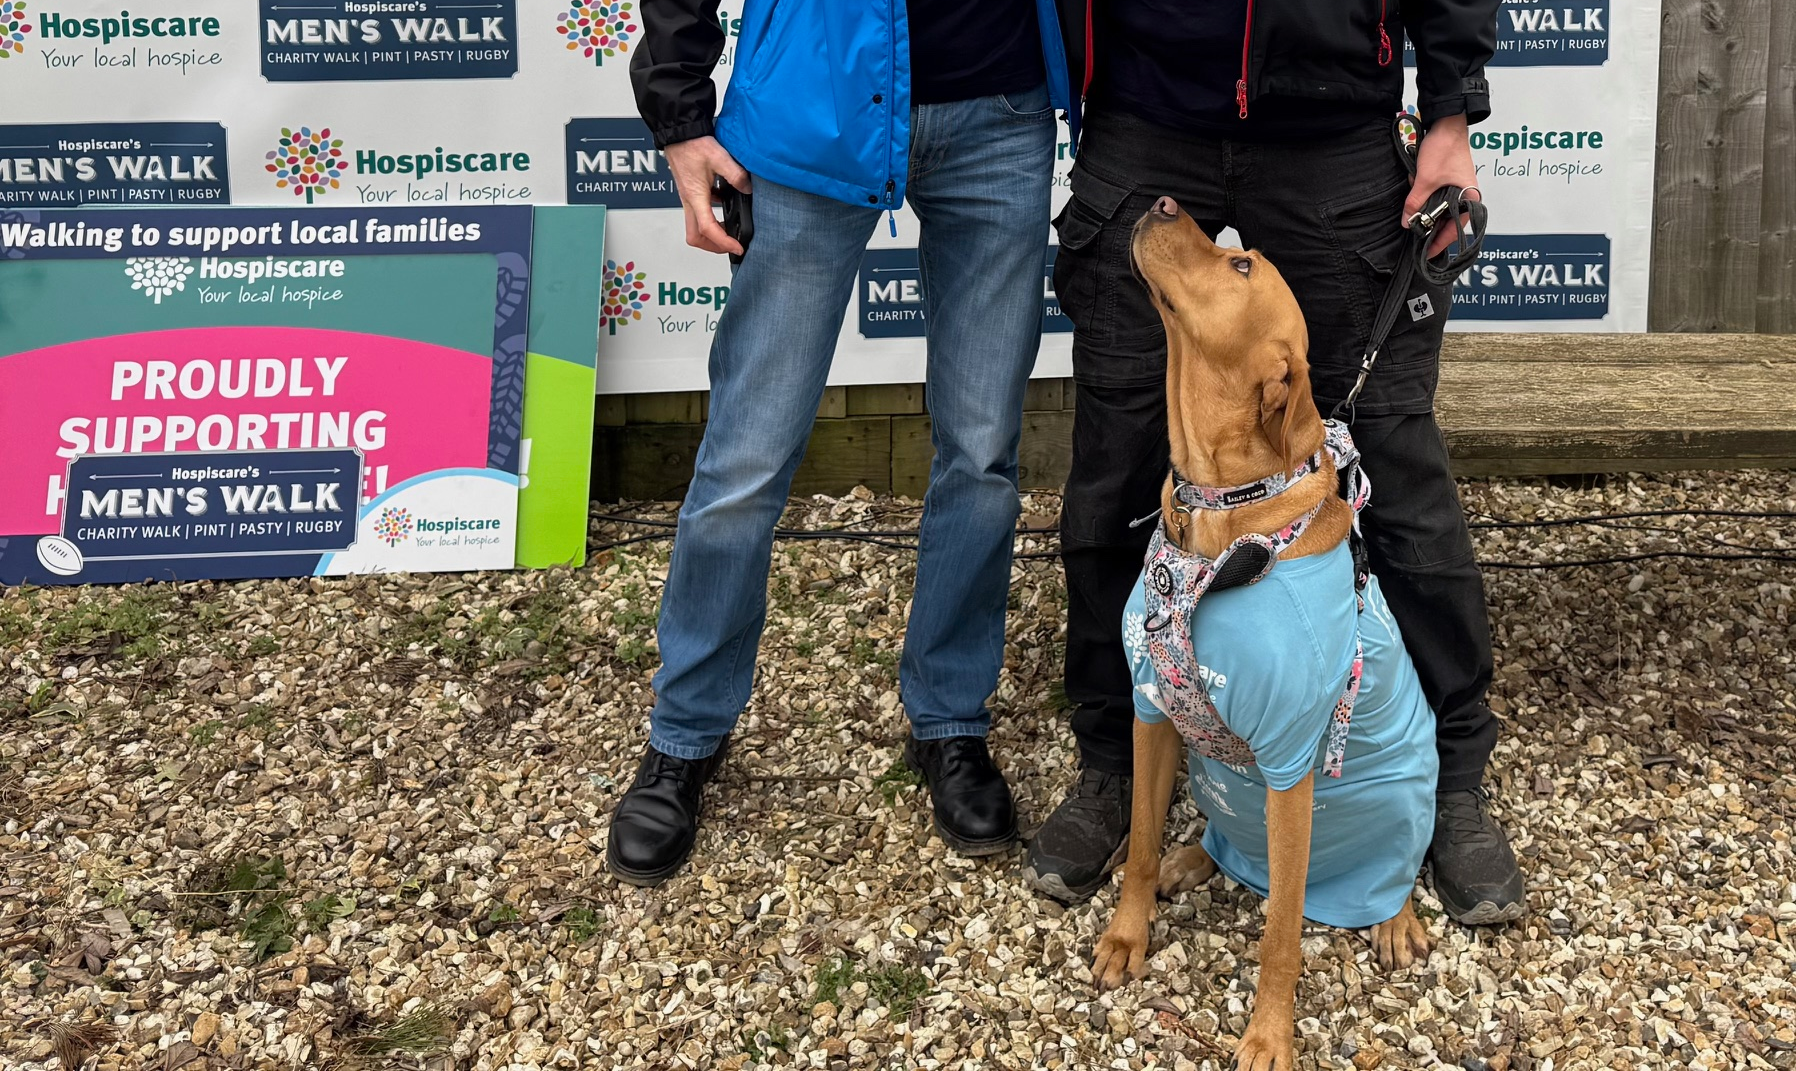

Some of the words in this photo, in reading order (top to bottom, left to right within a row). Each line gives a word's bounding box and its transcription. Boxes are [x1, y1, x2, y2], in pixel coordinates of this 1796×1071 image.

[344, 0, 427, 16] Hospiscare's
[40, 10, 220, 45] Hospiscare
[266, 18, 382, 45] MEN'S
[396, 17, 509, 44] WALK
[1507, 8, 1605, 33] WALK
[267, 51, 320, 64] CHARITY
[323, 51, 361, 64] WALK
[372, 50, 402, 63] PINT
[414, 50, 455, 62] PASTY
[466, 49, 510, 62] RUGBY
[1496, 40, 1515, 50] INT
[1525, 40, 1558, 50] PASTY
[1569, 39, 1607, 50] RUGBY
[41, 49, 84, 69] Your
[94, 48, 136, 69] local
[148, 49, 222, 75] hospice
[58, 138, 141, 153] Hospiscare's
[1470, 125, 1604, 156] ospiscare
[106, 155, 219, 183] WALK
[356, 147, 531, 179] Hospiscare
[575, 149, 671, 175] MEN'
[1494, 158, 1531, 177] local
[1539, 159, 1603, 184] hospice
[0, 190, 34, 202] ARITY
[38, 190, 75, 201] WALK
[88, 189, 118, 200] PINT
[129, 188, 169, 200] PASTY
[177, 187, 221, 200] RUGBY
[356, 184, 398, 204] Your
[408, 183, 448, 203] local
[459, 184, 532, 205] hospice
[576, 181, 628, 193] CHARITY
[631, 180, 666, 192] WALK
[1, 222, 124, 253] Walking
[131, 225, 160, 247] to
[168, 220, 284, 252] support
[290, 218, 359, 245] local
[366, 217, 481, 244] families
[1477, 249, 1539, 261] ospiscare's
[199, 256, 345, 283] Hospiscare
[1508, 263, 1606, 288] WALK
[198, 286, 231, 304] Your
[238, 285, 274, 304] local
[282, 286, 344, 309] hospice
[1489, 294, 1515, 305] PINT
[1525, 293, 1559, 304] PASTY
[1569, 292, 1607, 304] RUGBY
[658, 315, 696, 334] Your
[867, 310, 917, 322] CHARITY
[111, 356, 348, 401] PROUDLY
[56, 410, 387, 459] SUPPORTING
[172, 466, 260, 481] Hospiscare's
[80, 486, 208, 519] MEN'S
[219, 482, 343, 514] WALK
[77, 526, 140, 540] CHARITY
[141, 525, 181, 539] WALK
[194, 523, 227, 537] PINT
[239, 521, 283, 535] PASTY
[295, 519, 343, 534] RUGBY
[417, 516, 501, 534] Hospiscare
[415, 535, 436, 548] Your
[439, 534, 461, 546] local
[464, 534, 501, 550] hospice
